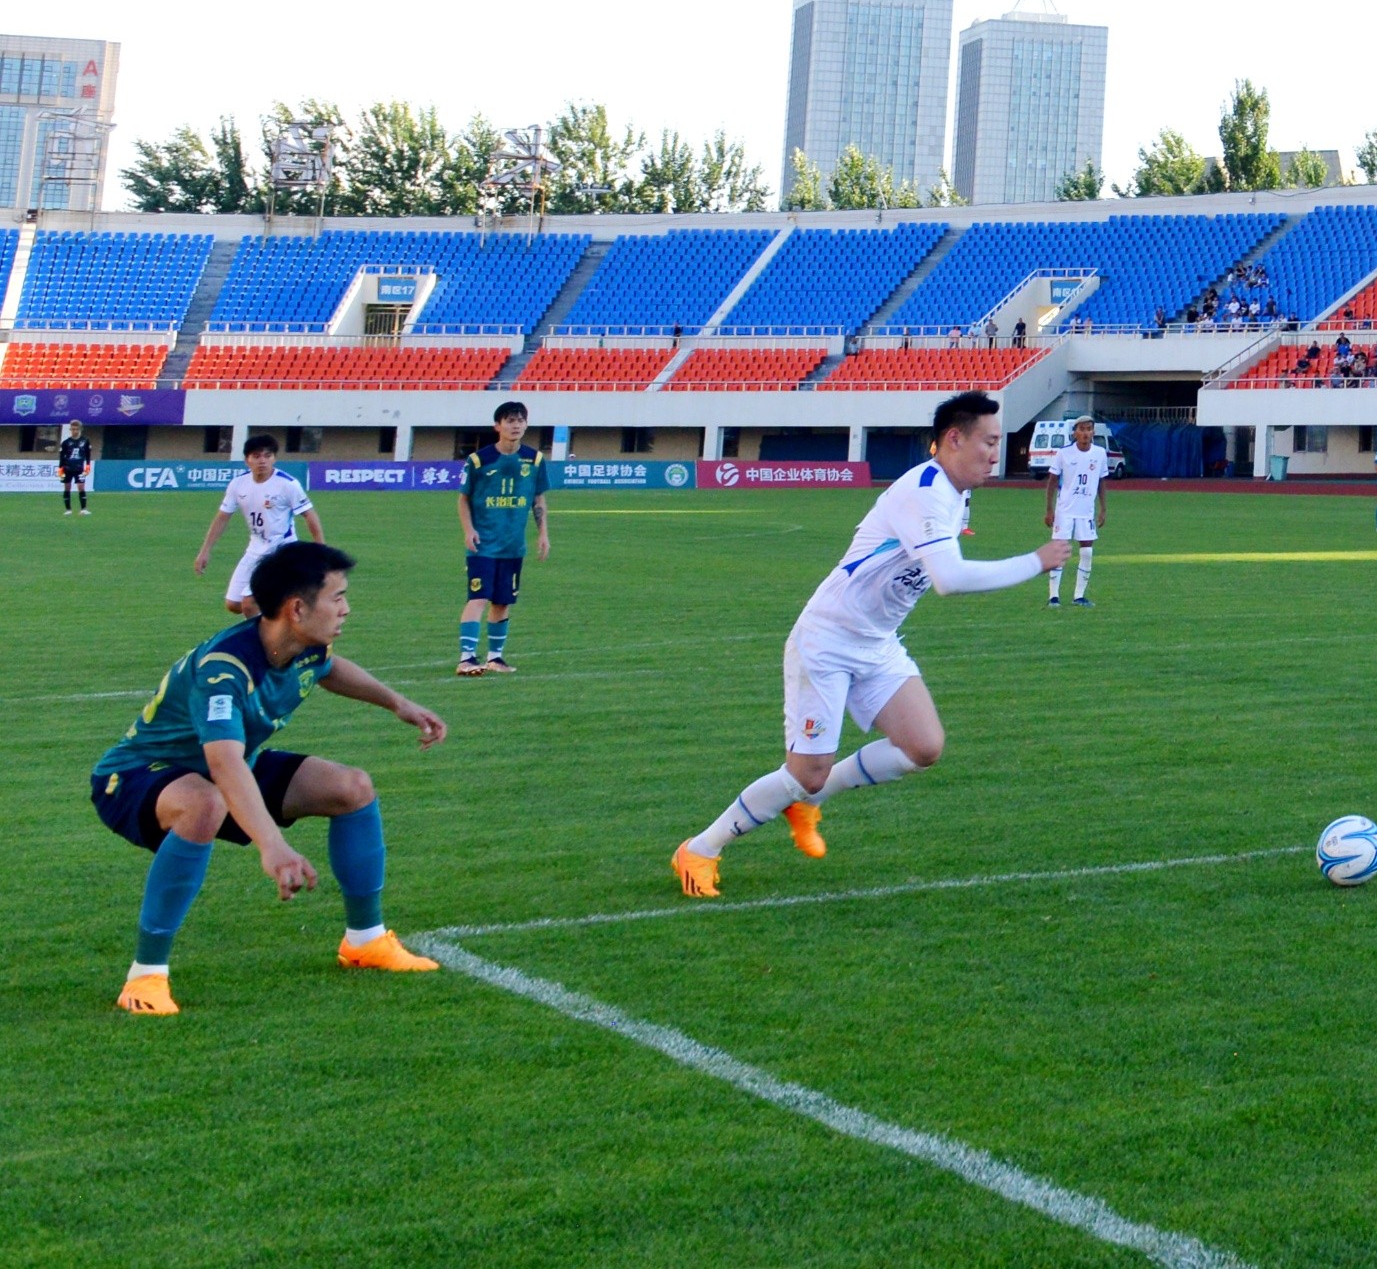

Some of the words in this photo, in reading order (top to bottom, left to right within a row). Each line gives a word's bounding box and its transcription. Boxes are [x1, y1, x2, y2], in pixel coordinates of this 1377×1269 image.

[127, 467, 179, 488] CFA
[325, 469, 405, 483] RESPECT
[564, 464, 647, 477] 中国足球协会
[746, 467, 853, 483] 中国企业体育协会
[502, 478, 514, 494] 11
[1078, 474, 1087, 485] 10
[250, 512, 264, 527] 16
